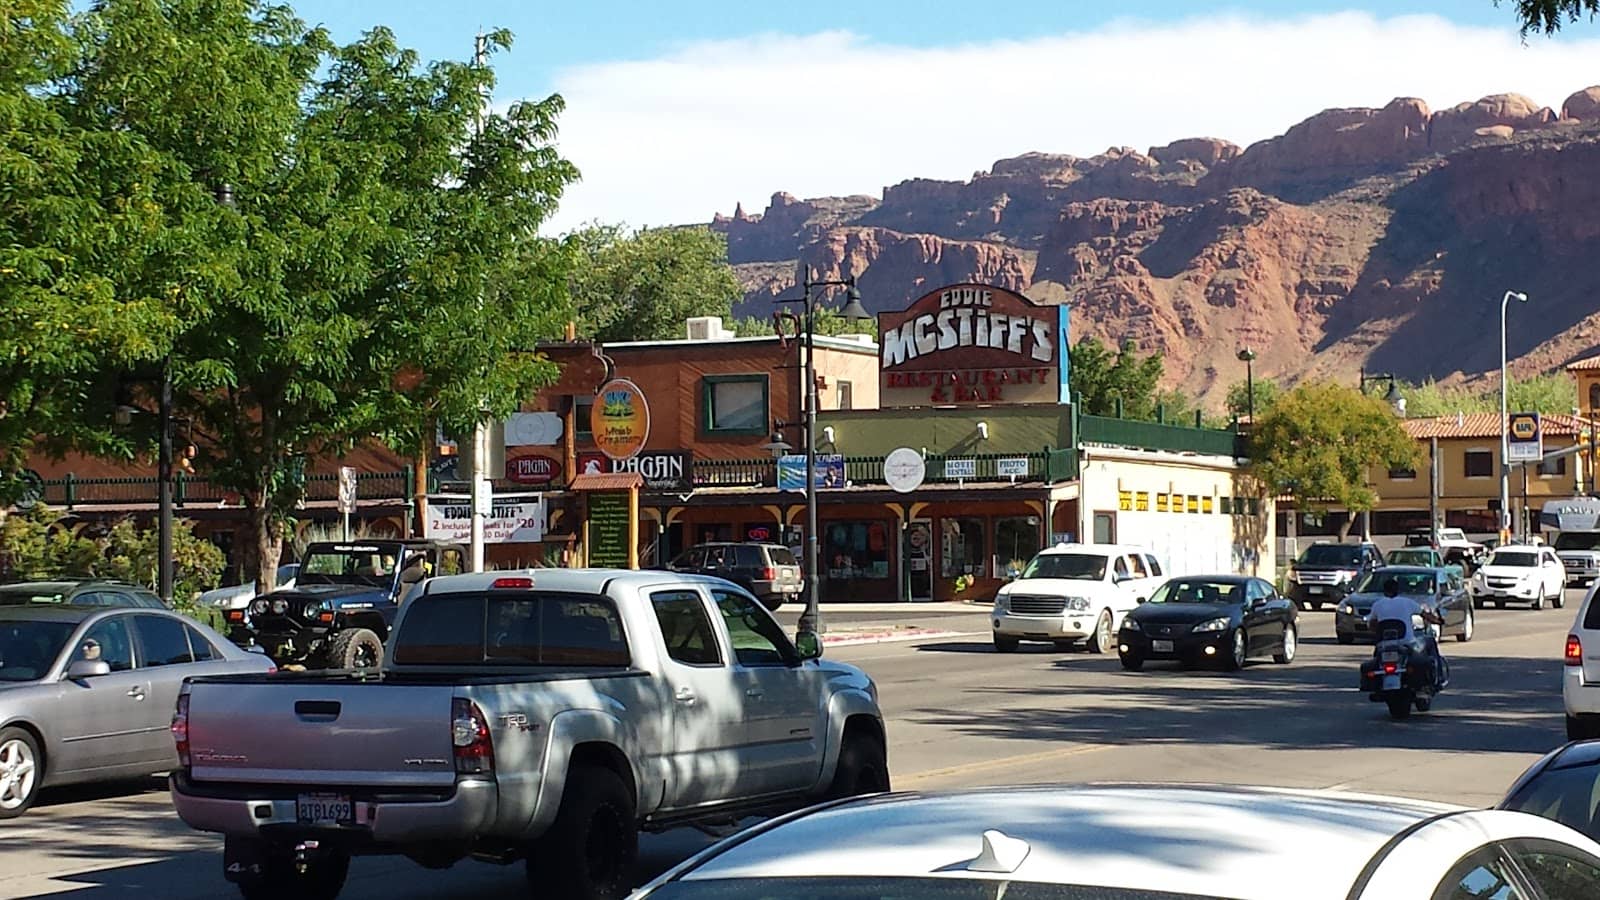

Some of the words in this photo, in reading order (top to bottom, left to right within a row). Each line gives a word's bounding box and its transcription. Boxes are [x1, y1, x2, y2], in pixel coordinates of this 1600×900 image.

[940, 288, 993, 309] EDDIE
[885, 369, 1051, 389] RESTAURANT
[930, 388, 949, 403] &
[953, 386, 1003, 403] BAR
[518, 459, 551, 474] PAGAN
[946, 461, 974, 469] MOVIE
[1000, 460, 1026, 469] PHOTO
[433, 520, 439, 530] 2
[498, 714, 528, 729] TRD
